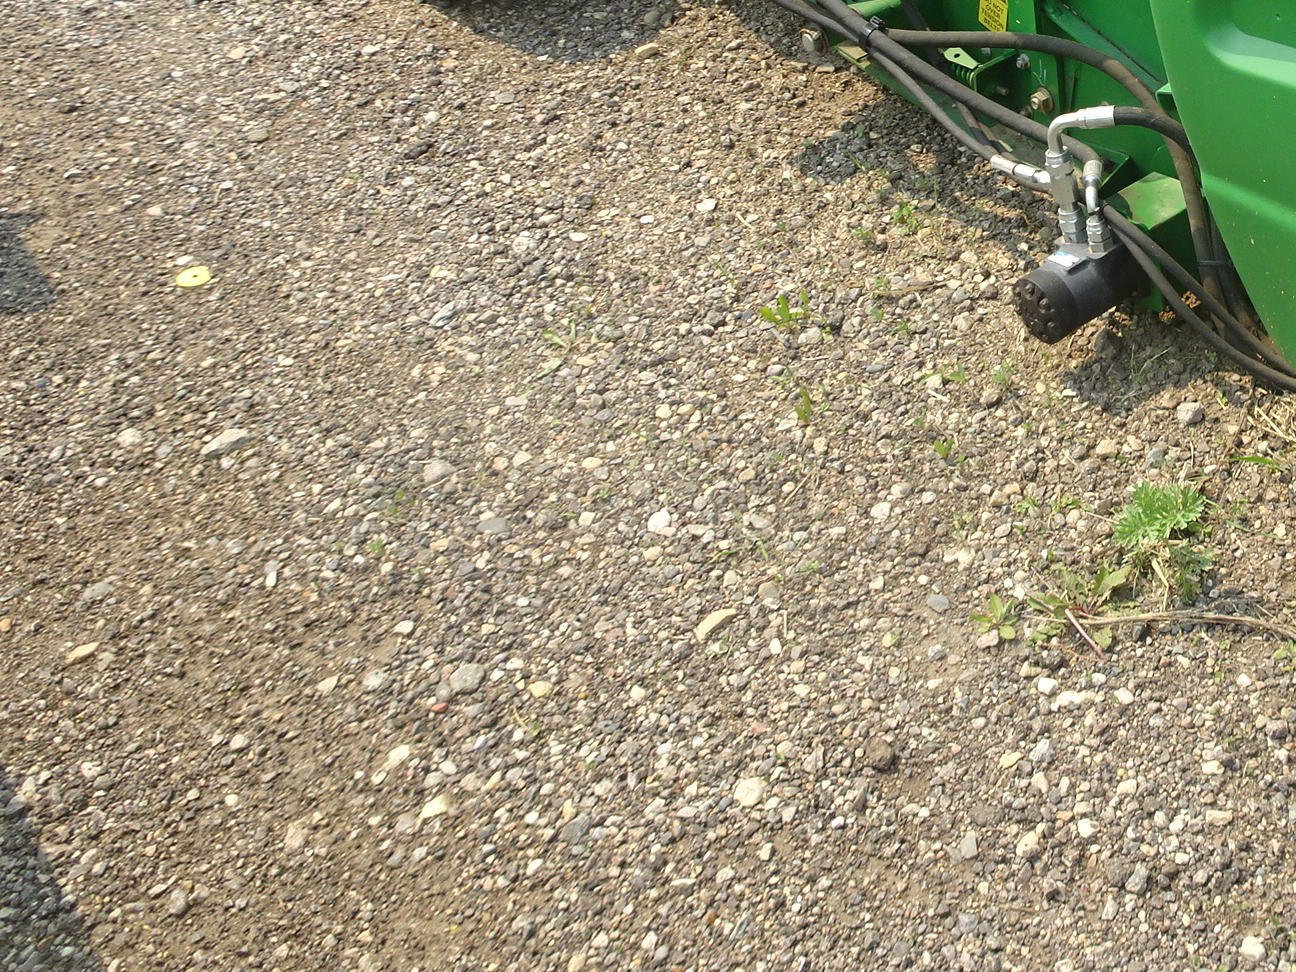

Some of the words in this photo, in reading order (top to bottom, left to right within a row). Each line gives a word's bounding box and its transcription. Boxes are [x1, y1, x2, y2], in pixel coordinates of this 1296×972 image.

[985, 4, 1000, 19] OVER
[992, 2, 1004, 14] NOT
[982, 7, 1004, 29] TENSION
